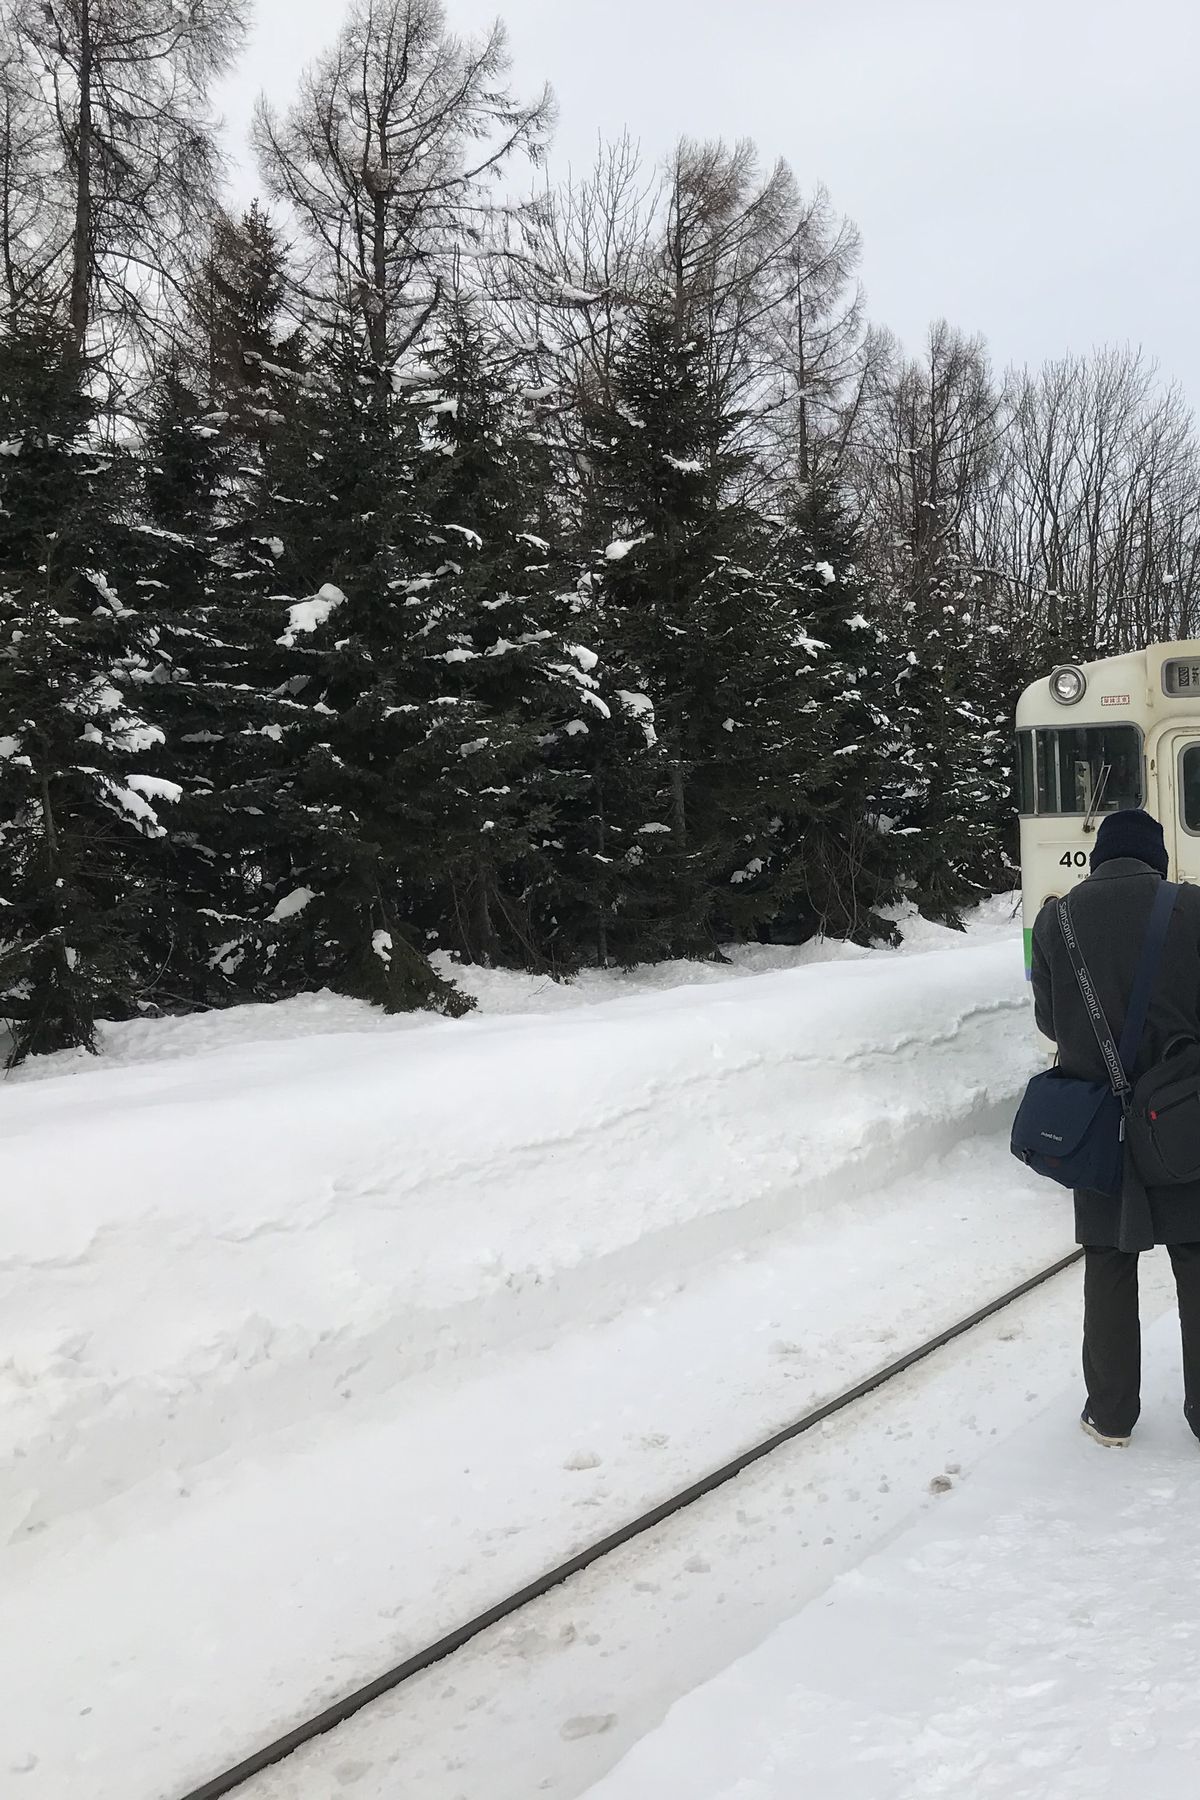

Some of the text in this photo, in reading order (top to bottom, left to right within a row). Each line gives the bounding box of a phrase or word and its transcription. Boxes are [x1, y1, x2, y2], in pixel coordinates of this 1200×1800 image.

[1059, 851, 1087, 868] 40
[1058, 901, 1075, 949] Samsonite
[1077, 967, 1101, 1020] Samsonite
